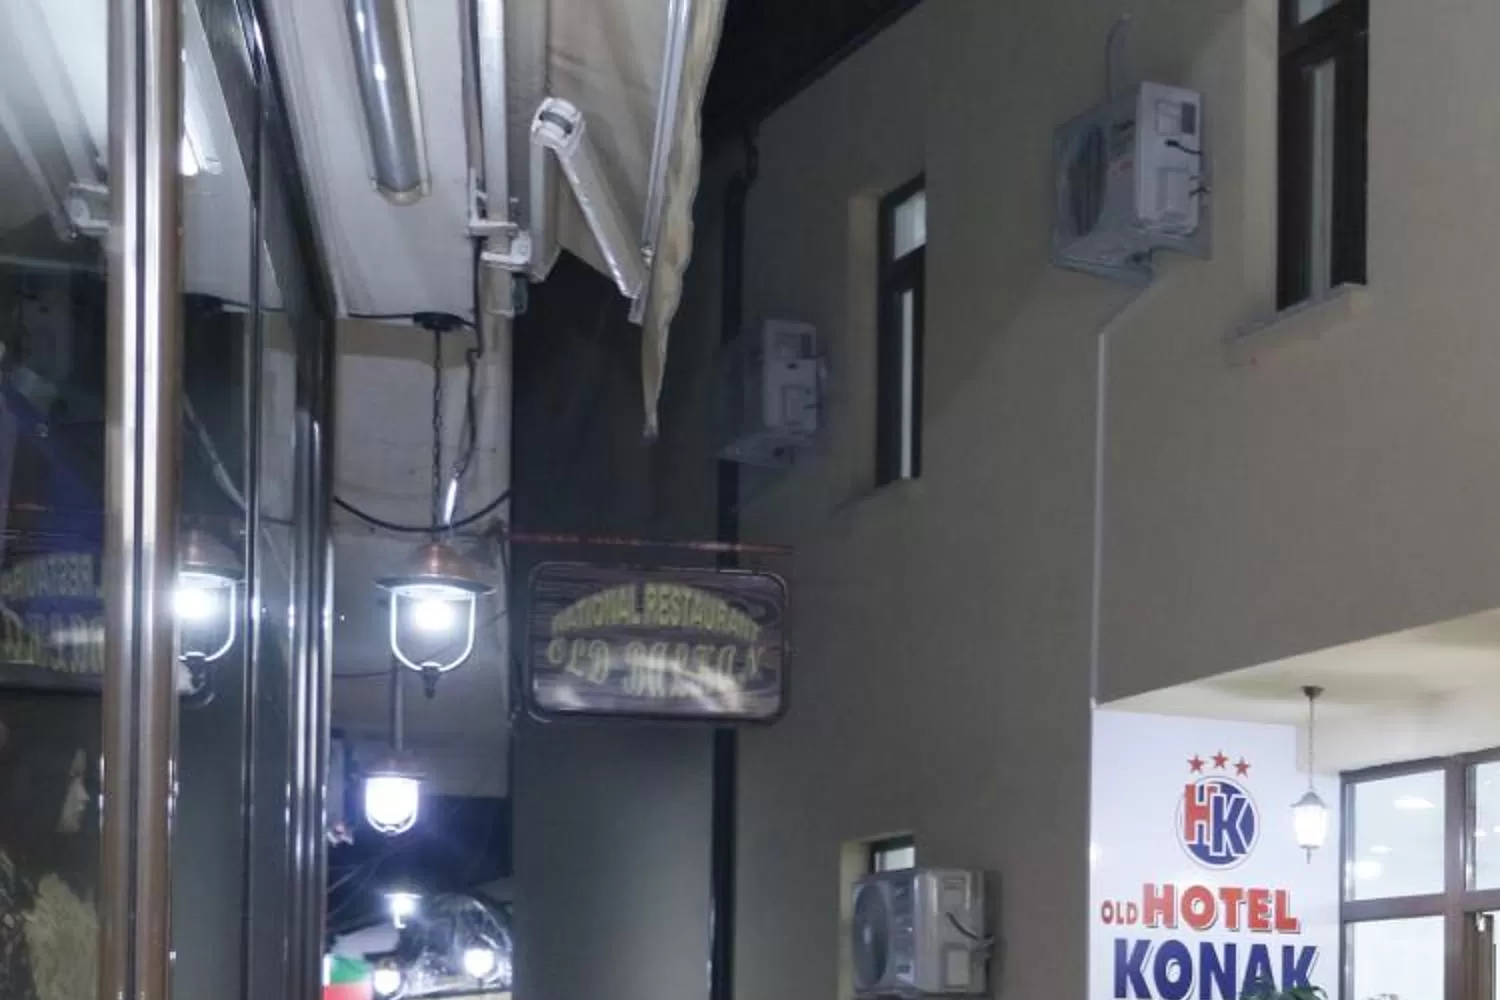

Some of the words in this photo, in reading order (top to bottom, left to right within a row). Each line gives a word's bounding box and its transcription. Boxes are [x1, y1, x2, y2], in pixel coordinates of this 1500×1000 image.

[1184, 783, 1249, 856] HK
[1101, 899, 1139, 926] OLD
[1142, 882, 1301, 934] HOTEL
